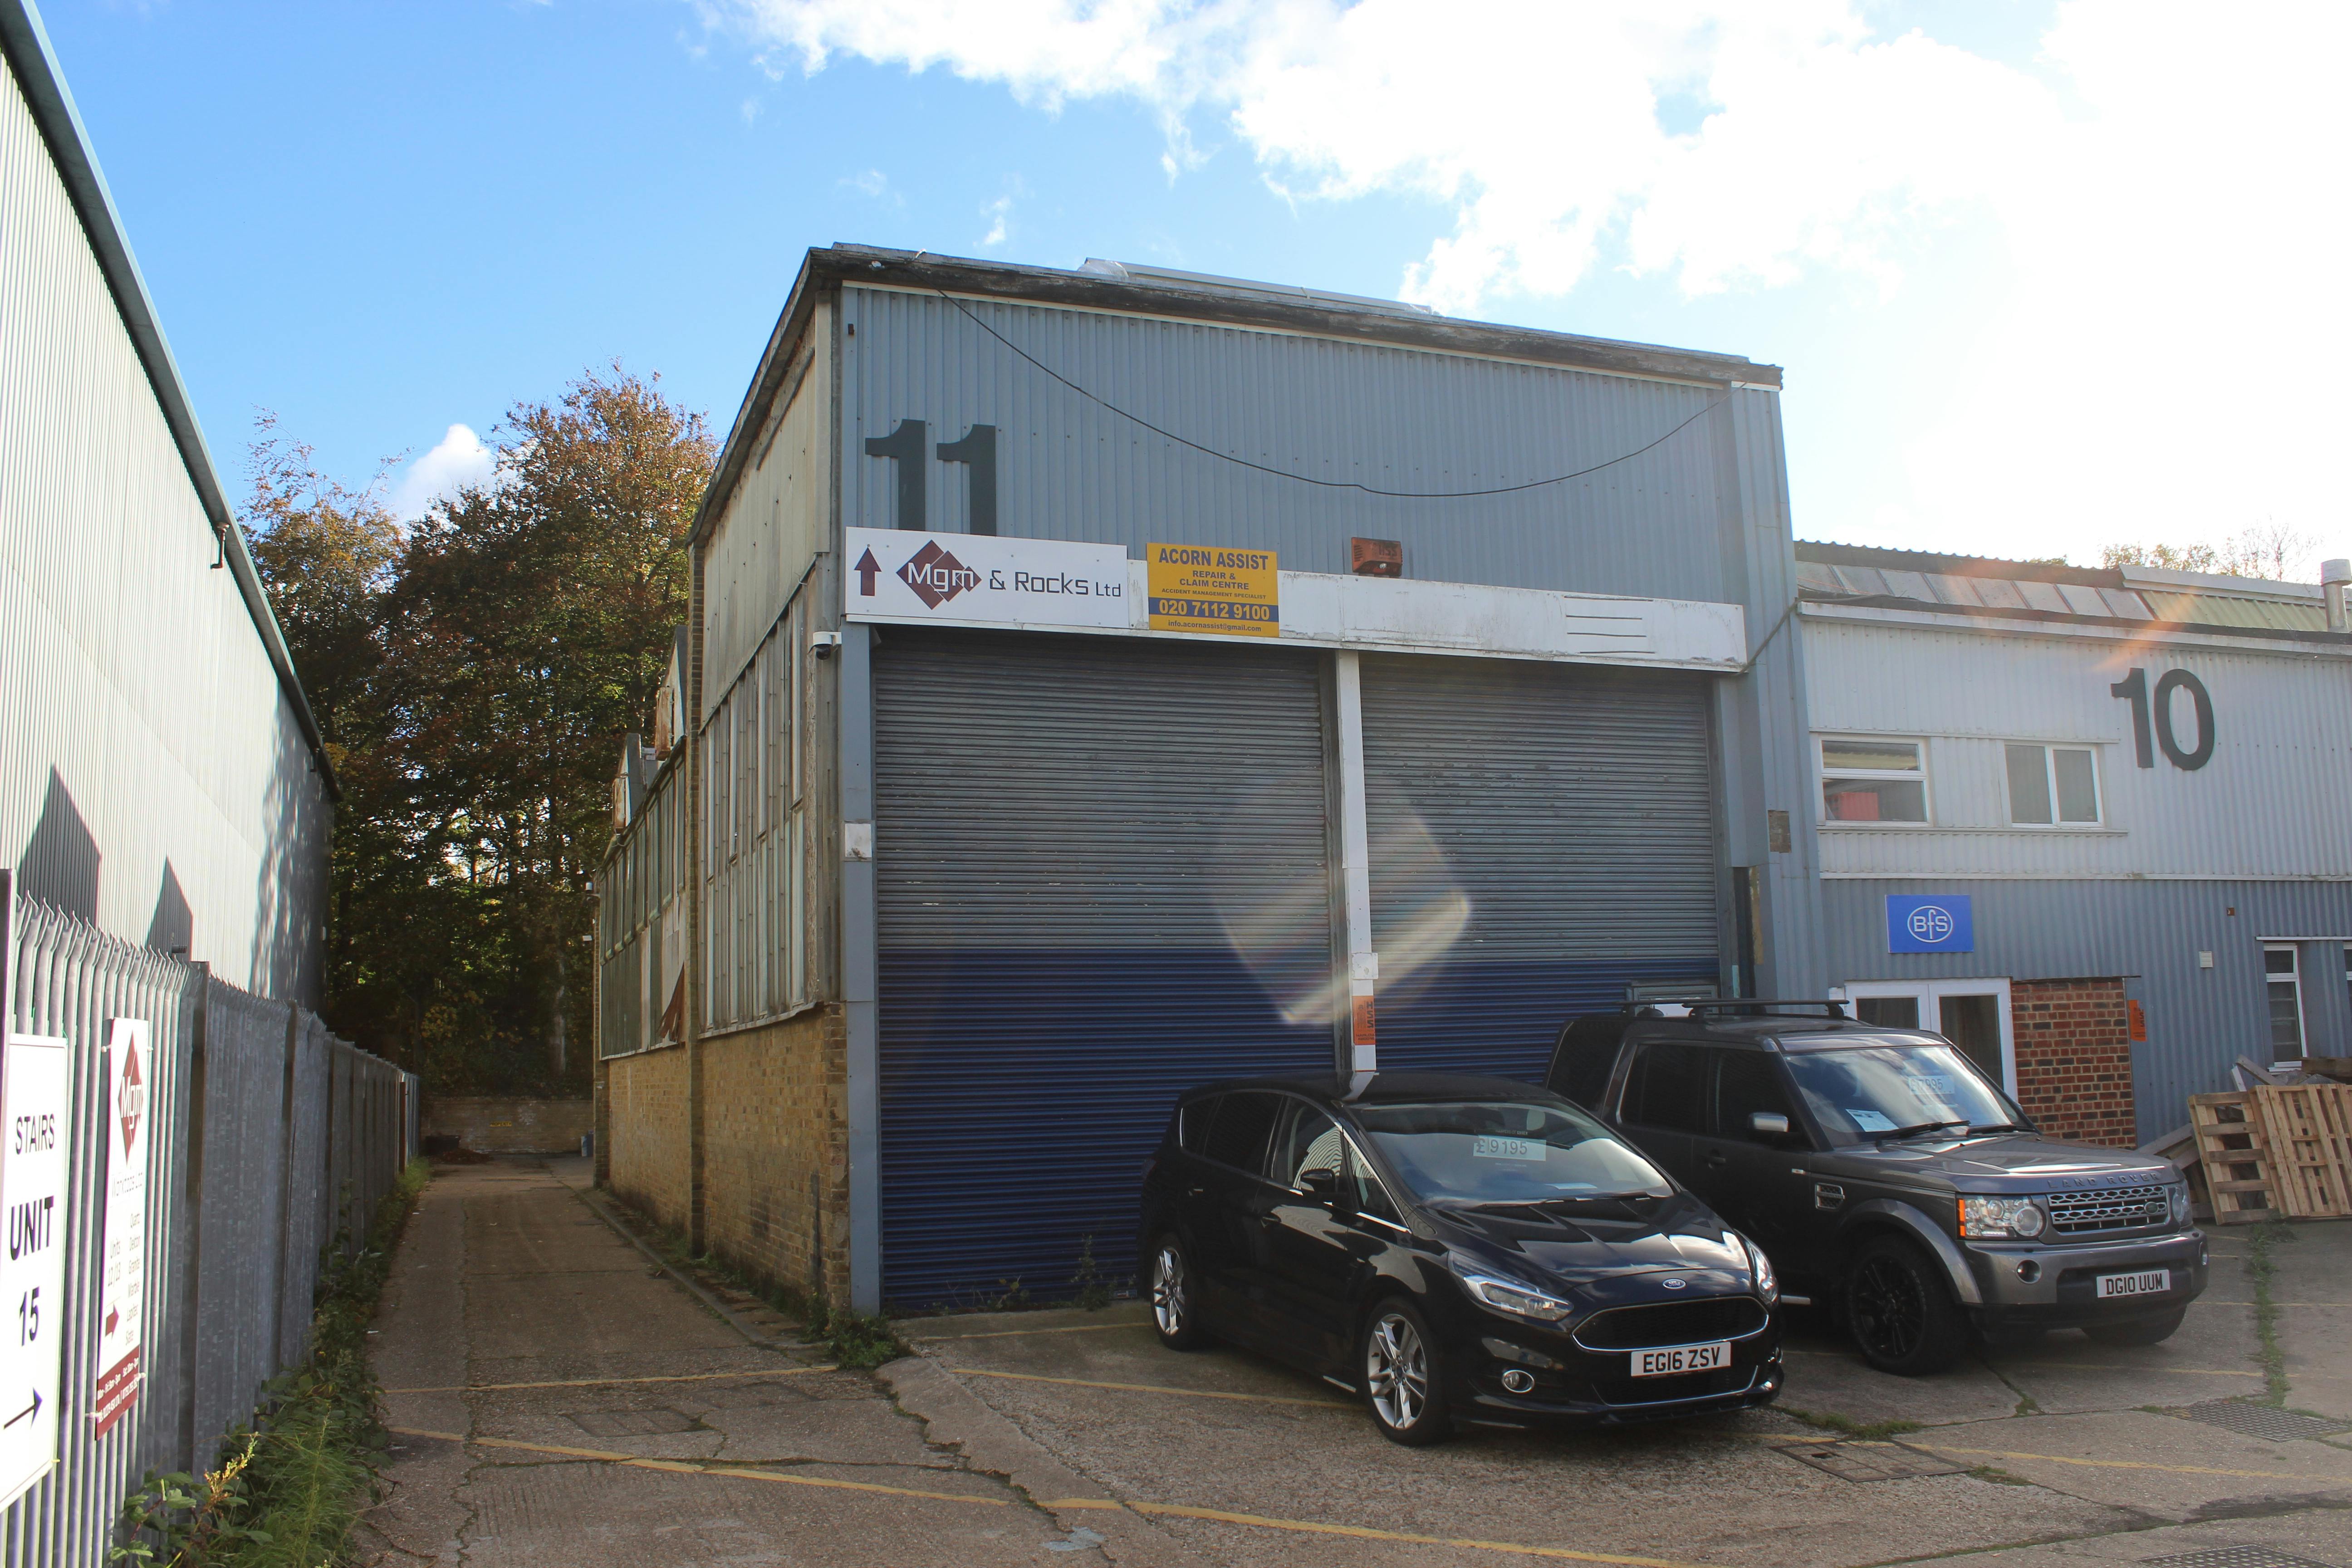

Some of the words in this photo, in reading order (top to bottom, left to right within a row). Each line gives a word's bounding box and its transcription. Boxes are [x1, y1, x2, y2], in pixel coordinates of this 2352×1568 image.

[865, 419, 997, 535] 11
[1158, 548, 1211, 567] ACORN
[1216, 552, 1269, 570] ASSIST
[908, 562, 974, 592] Mgm
[990, 570, 1006, 591] &
[1015, 572, 1089, 595] Rocks
[1096, 582, 1122, 598] Ltd
[1179, 578, 1209, 588] CLAIM
[1212, 580, 1249, 590] CENTRE
[1192, 570, 1226, 579] REPAIR
[1159, 599, 1188, 615] 020
[1192, 602, 1229, 618] 7112
[1234, 604, 1270, 621] 9100
[1168, 619, 1261, 632] info.acornassist@gmail.com
[2111, 667, 2215, 771] 10
[121, 1076, 142, 1130] Mgm
[15, 1113, 55, 1155] STAIRS
[2048, 1177, 2097, 1189] LAND
[2107, 1172, 2161, 1185] ROVER
[10, 1195, 54, 1261] UNIT
[2106, 1276, 2136, 1295] DG10
[2139, 1273, 2163, 1292] UUM
[20, 1286, 40, 1347] 15
[1643, 1351, 1683, 1373] EG16
[1688, 1346, 1720, 1369] ZSV
